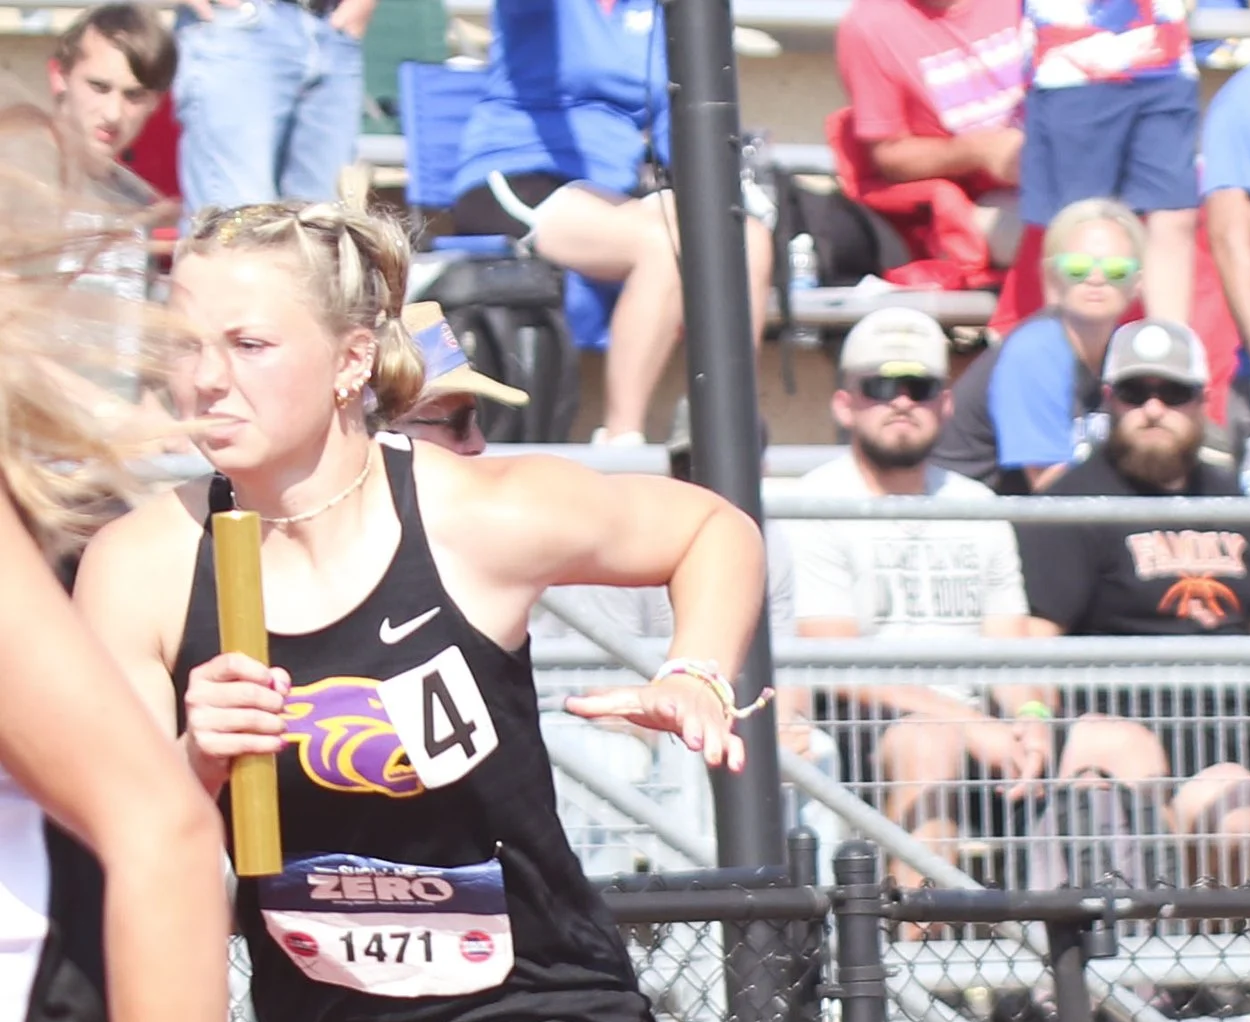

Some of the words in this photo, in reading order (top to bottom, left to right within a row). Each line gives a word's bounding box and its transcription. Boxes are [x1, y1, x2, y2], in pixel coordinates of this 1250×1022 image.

[422, 669, 477, 759] 4
[307, 873, 454, 901] ZERO
[339, 930, 433, 963] 1471
